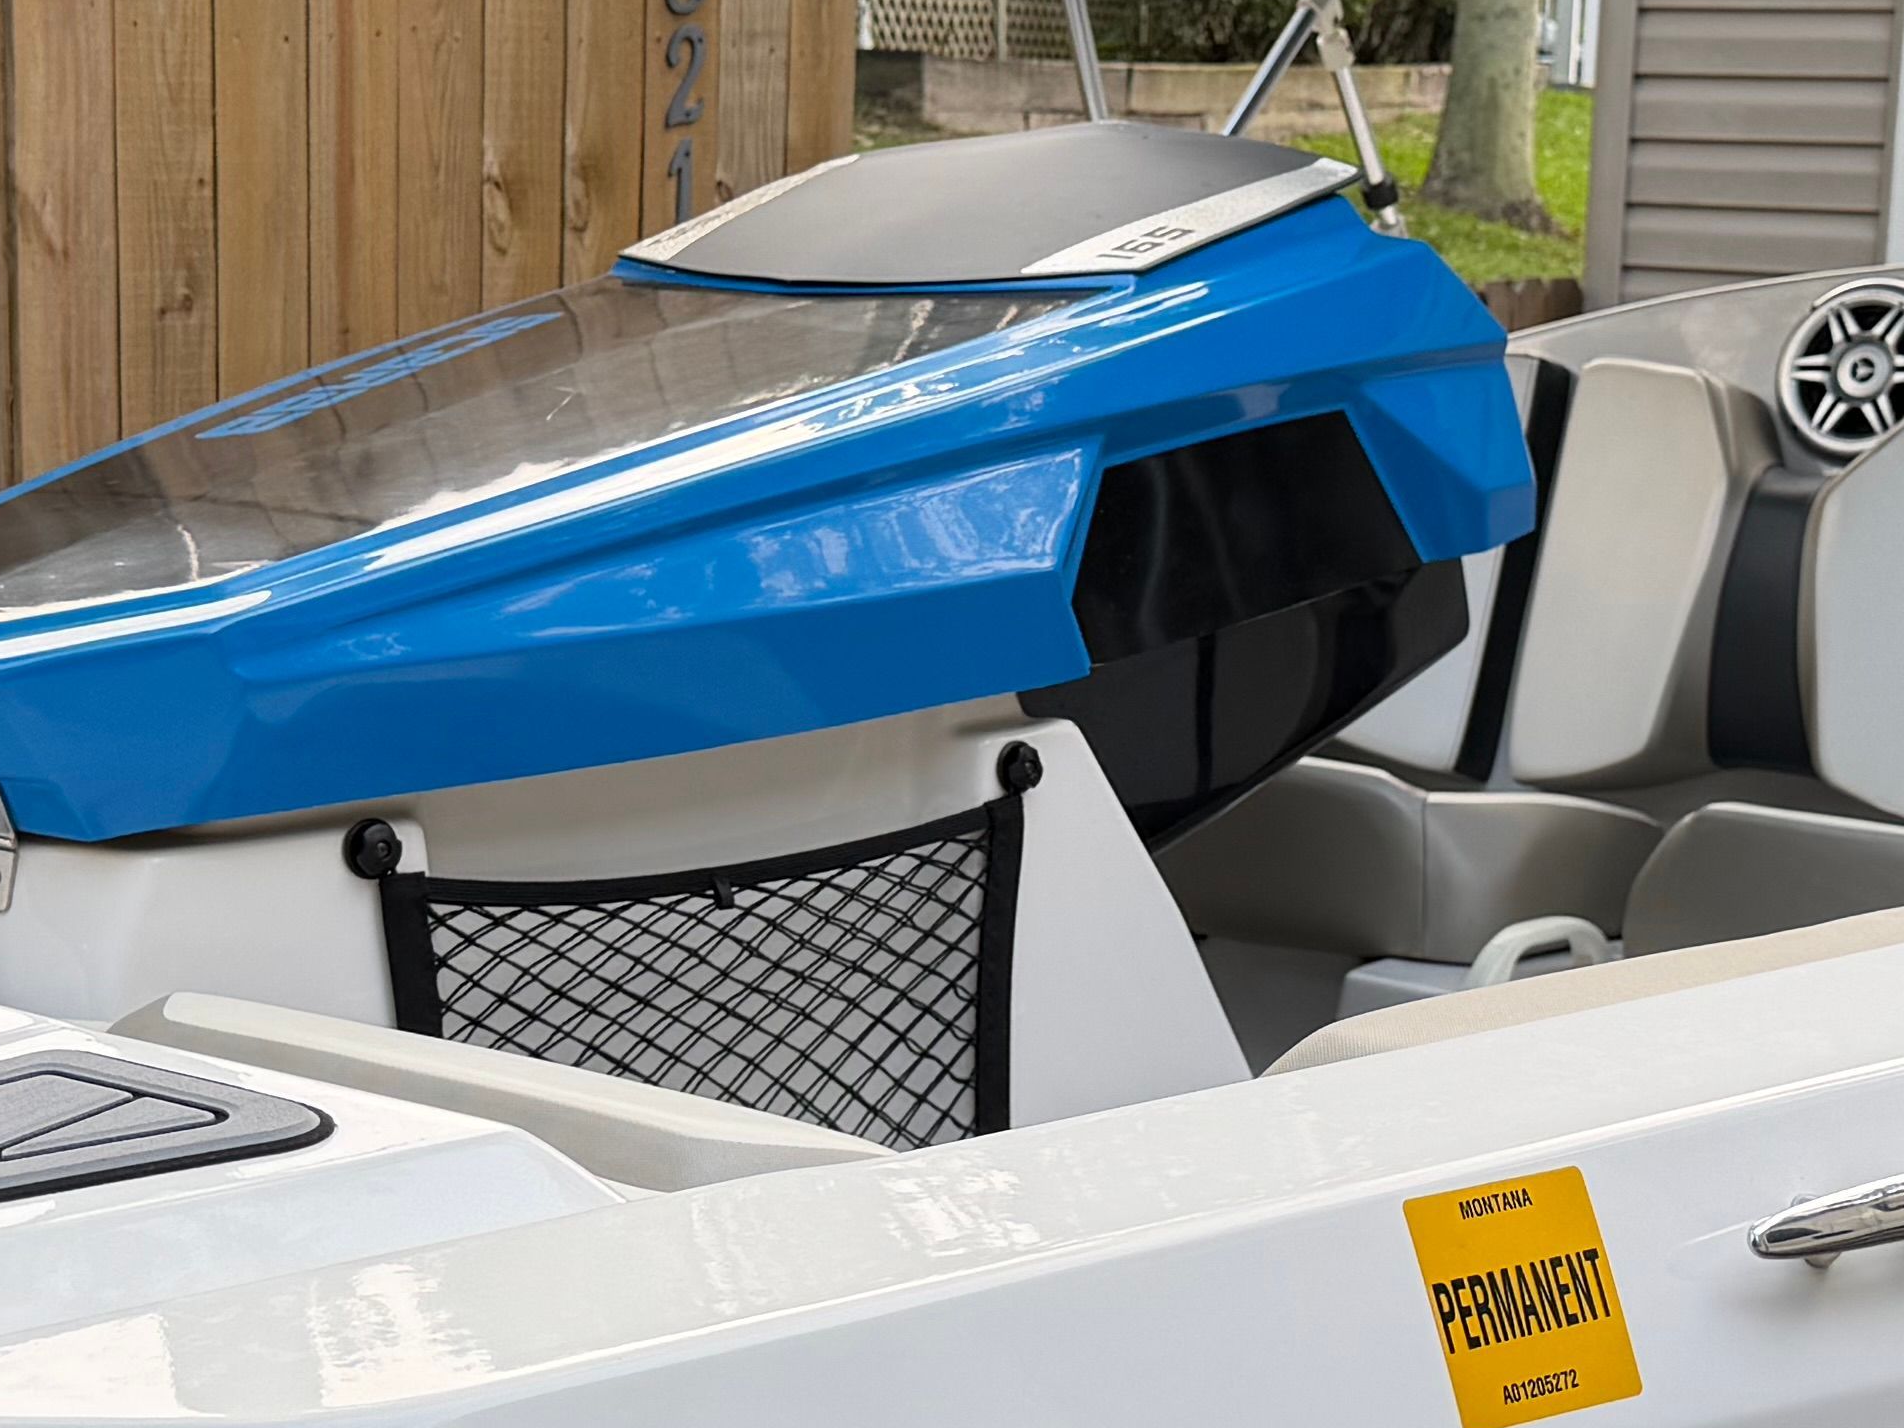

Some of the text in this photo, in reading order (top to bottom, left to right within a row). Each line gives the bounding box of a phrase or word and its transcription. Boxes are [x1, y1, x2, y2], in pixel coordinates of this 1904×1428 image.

[1096, 226, 1195, 259] 165
[1459, 1188, 1533, 1220] MONTANA
[1431, 1248, 1611, 1355] PERMANENT
[1503, 1368, 1580, 1405] A01205272
